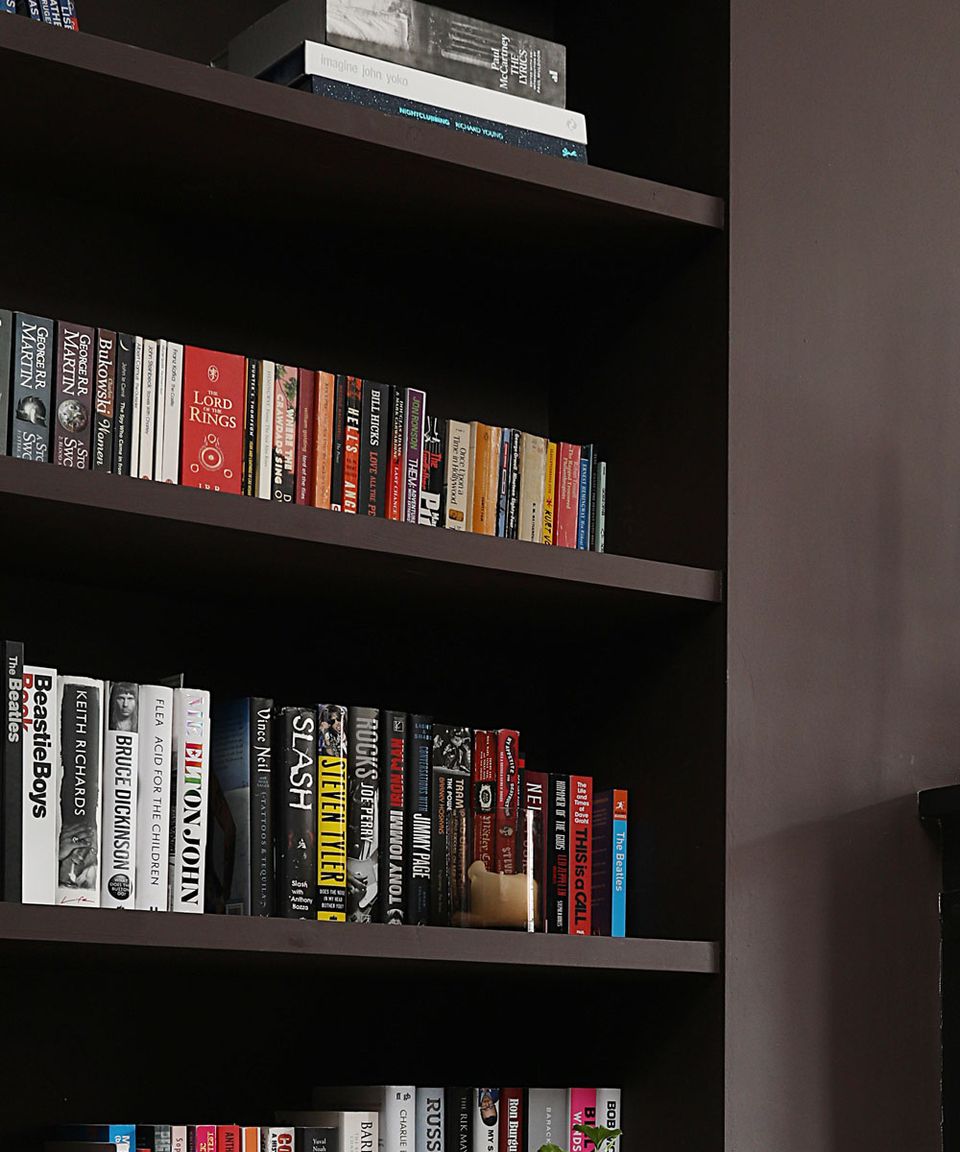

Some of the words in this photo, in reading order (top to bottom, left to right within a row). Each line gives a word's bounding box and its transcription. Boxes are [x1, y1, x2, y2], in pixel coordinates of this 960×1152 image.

[321, 53, 358, 73] imagine
[362, 64, 382, 78] john
[386, 72, 409, 86] yoko
[491, 47, 500, 71] Paul
[500, 33, 511, 90] McCartney
[511, 53, 519, 75] THE
[519, 49, 528, 85] LYRICS
[399, 107, 450, 126] NIGHTCLUBBING
[455, 121, 481, 134] RICHARD
[482, 127, 504, 140] YOUNG
[20, 321, 37, 389] MARTIN
[36, 327, 48, 369] GEORGE
[62, 328, 79, 395] MARTIN
[78, 334, 91, 375] GEORGE
[95, 337, 114, 416] Bukowski
[193, 390, 233, 410] LORD
[371, 389, 380, 412] BILL
[412, 396, 420, 414] JON
[189, 406, 237, 429] RINGS
[275, 394, 284, 453] CRAWDADS
[285, 408, 295, 445] WHERE
[345, 407, 359, 454] HELL'S
[369, 413, 380, 446] HICKS
[410, 415, 419, 449] RONSON
[96, 419, 111, 467] Women
[284, 448, 293, 471] THE
[459, 447, 468, 467] Once
[274, 454, 283, 484] SING
[368, 451, 378, 474] LOVE
[406, 459, 418, 486] THEM:
[430, 453, 442, 468] The
[450, 463, 459, 505] Hollywood
[458, 469, 466, 488] Upon
[544, 509, 553, 533] KURT
[8, 656, 18, 675] The
[8, 677, 22, 743] Beatles
[76, 690, 88, 734] KEITH
[155, 698, 165, 726] FLEA
[257, 707, 271, 742] Vince
[114, 735, 133, 786] BRUCE
[154, 736, 164, 766] ACID
[253, 745, 271, 773] Neil
[289, 715, 315, 810] SLASH
[355, 716, 379, 780] ROCKS
[389, 738, 404, 771] MAN
[75, 740, 87, 816] RICHARDS
[153, 769, 163, 793] FOR
[183, 742, 203, 826] ELTON
[418, 745, 429, 794] CONVERSATIONS
[321, 759, 346, 823] STEVEN
[361, 782, 374, 803] JOE
[389, 773, 404, 807] IRON
[555, 780, 566, 807] HAMMER
[152, 797, 162, 820] THE
[361, 806, 374, 842] PERRY
[555, 809, 566, 817] OF
[113, 789, 132, 871] DICKINSON
[389, 810, 404, 861] IOMMI
[412, 813, 431, 851] JIMMY
[555, 820, 566, 832] THE
[555, 834, 566, 850] GODS
[616, 831, 626, 850] The
[151, 823, 161, 886] CHILDREN
[320, 831, 346, 882] TYLER
[575, 828, 588, 862] THIS
[181, 828, 201, 905] JOHN
[259, 857, 267, 899] TEQUILA
[412, 852, 431, 879] PAGE
[575, 865, 587, 876] is
[615, 853, 626, 892] Beatles
[292, 880, 308, 888] Slash
[389, 863, 403, 904] TONY
[575, 878, 585, 889] a
[575, 891, 588, 925] CALL
[459, 1113, 468, 1131] RIK
[508, 1098, 519, 1119] Ron
[606, 1100, 616, 1128] BOB
[399, 1109, 407, 1147] CHARLIE
[487, 1129, 494, 1143] MY
